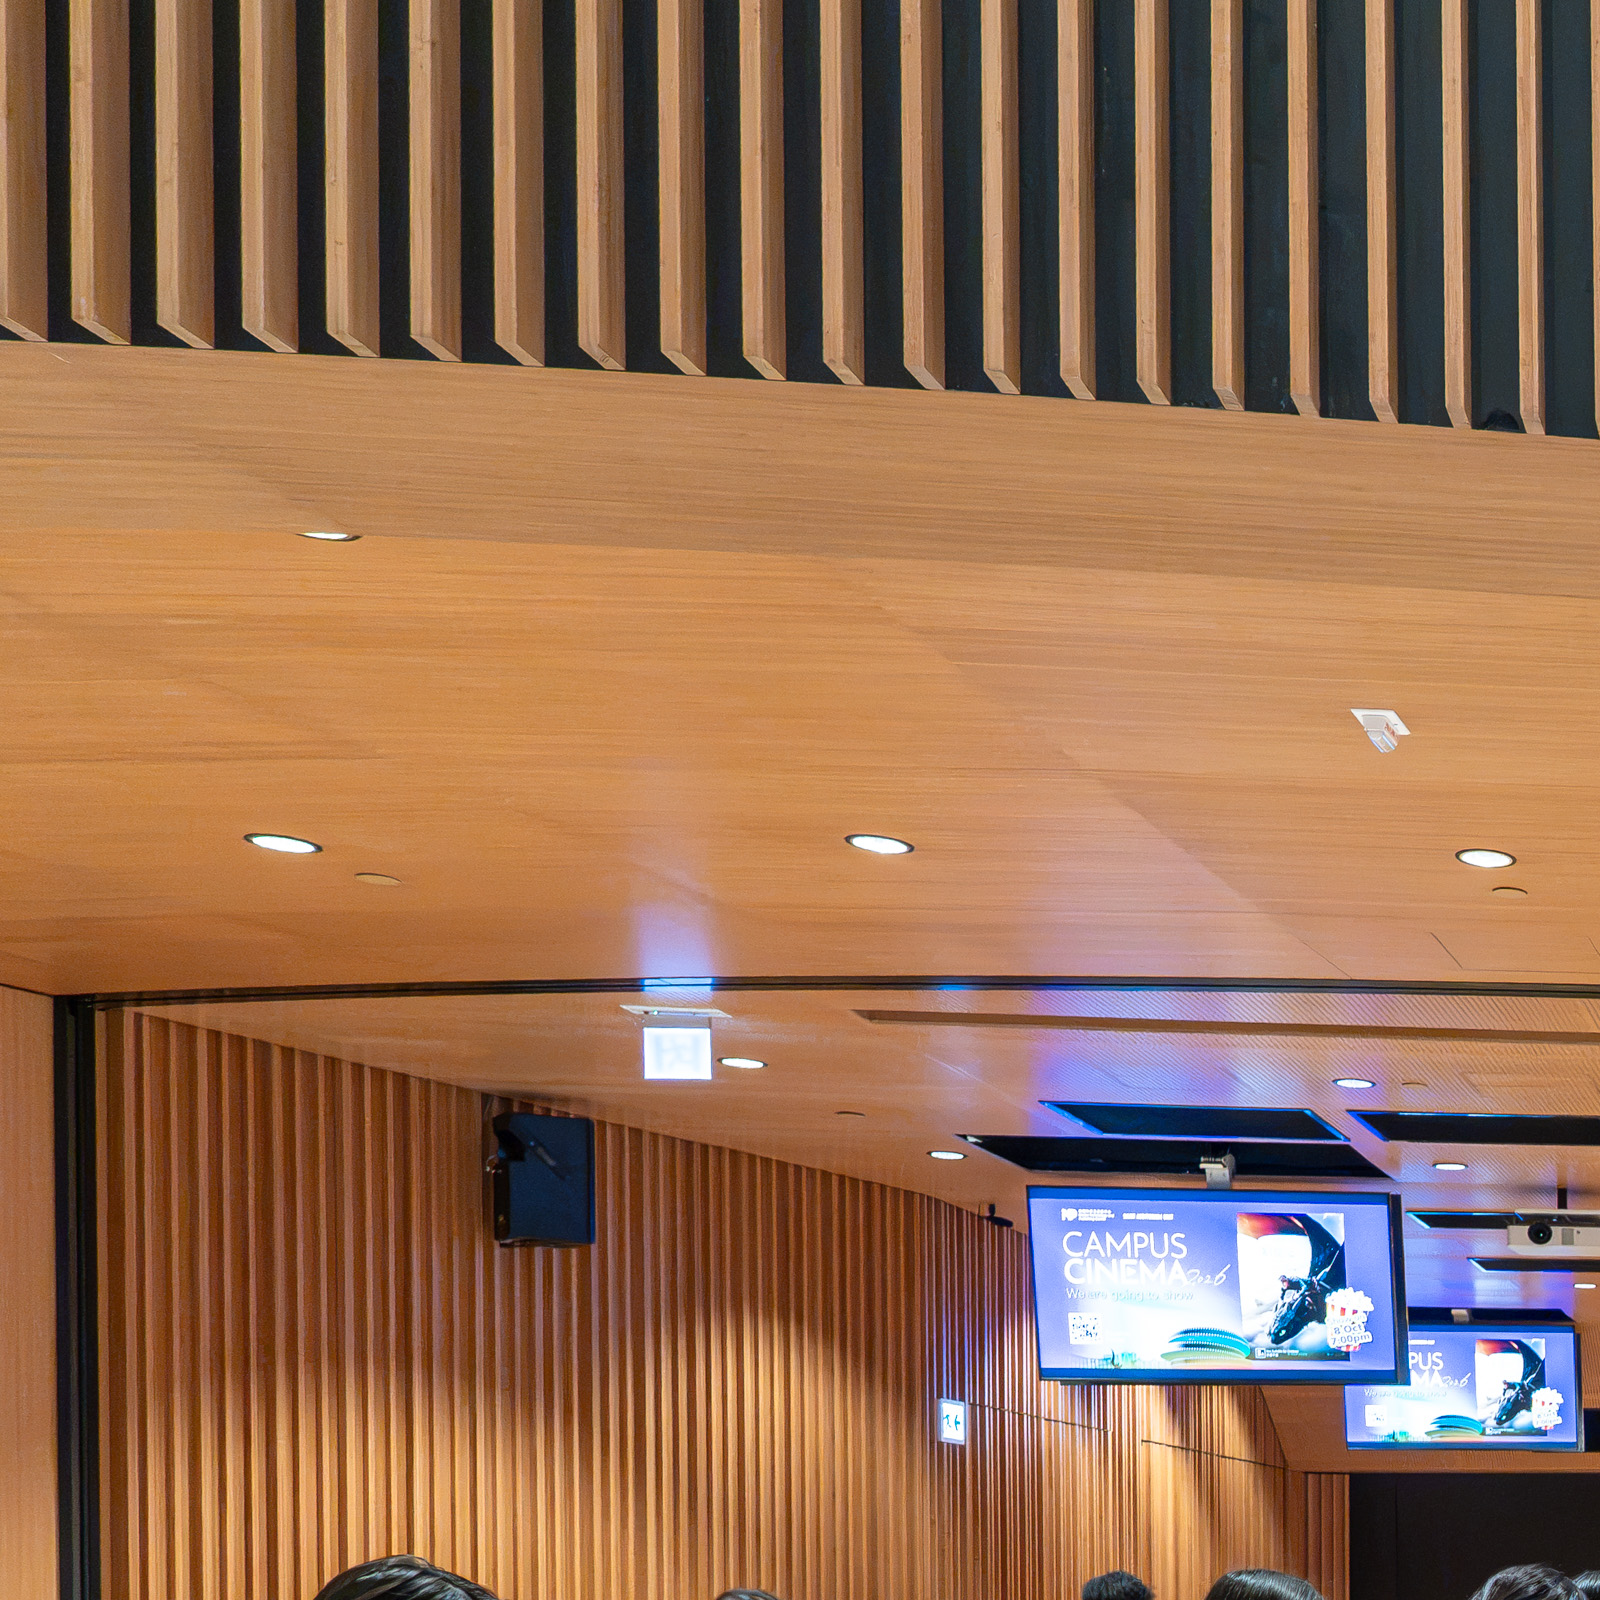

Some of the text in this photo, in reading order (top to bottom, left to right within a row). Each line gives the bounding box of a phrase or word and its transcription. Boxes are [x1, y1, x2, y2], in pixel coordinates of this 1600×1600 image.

[1062, 1230, 1188, 1259] CAMPUS
[1063, 1258, 1189, 1286] CINEMA
[1065, 1287, 1085, 1300] We
[1333, 1323, 1363, 1335] 8 Oct
[1331, 1333, 1371, 1346] 7:00pm
[1409, 1351, 1444, 1371] PUS
